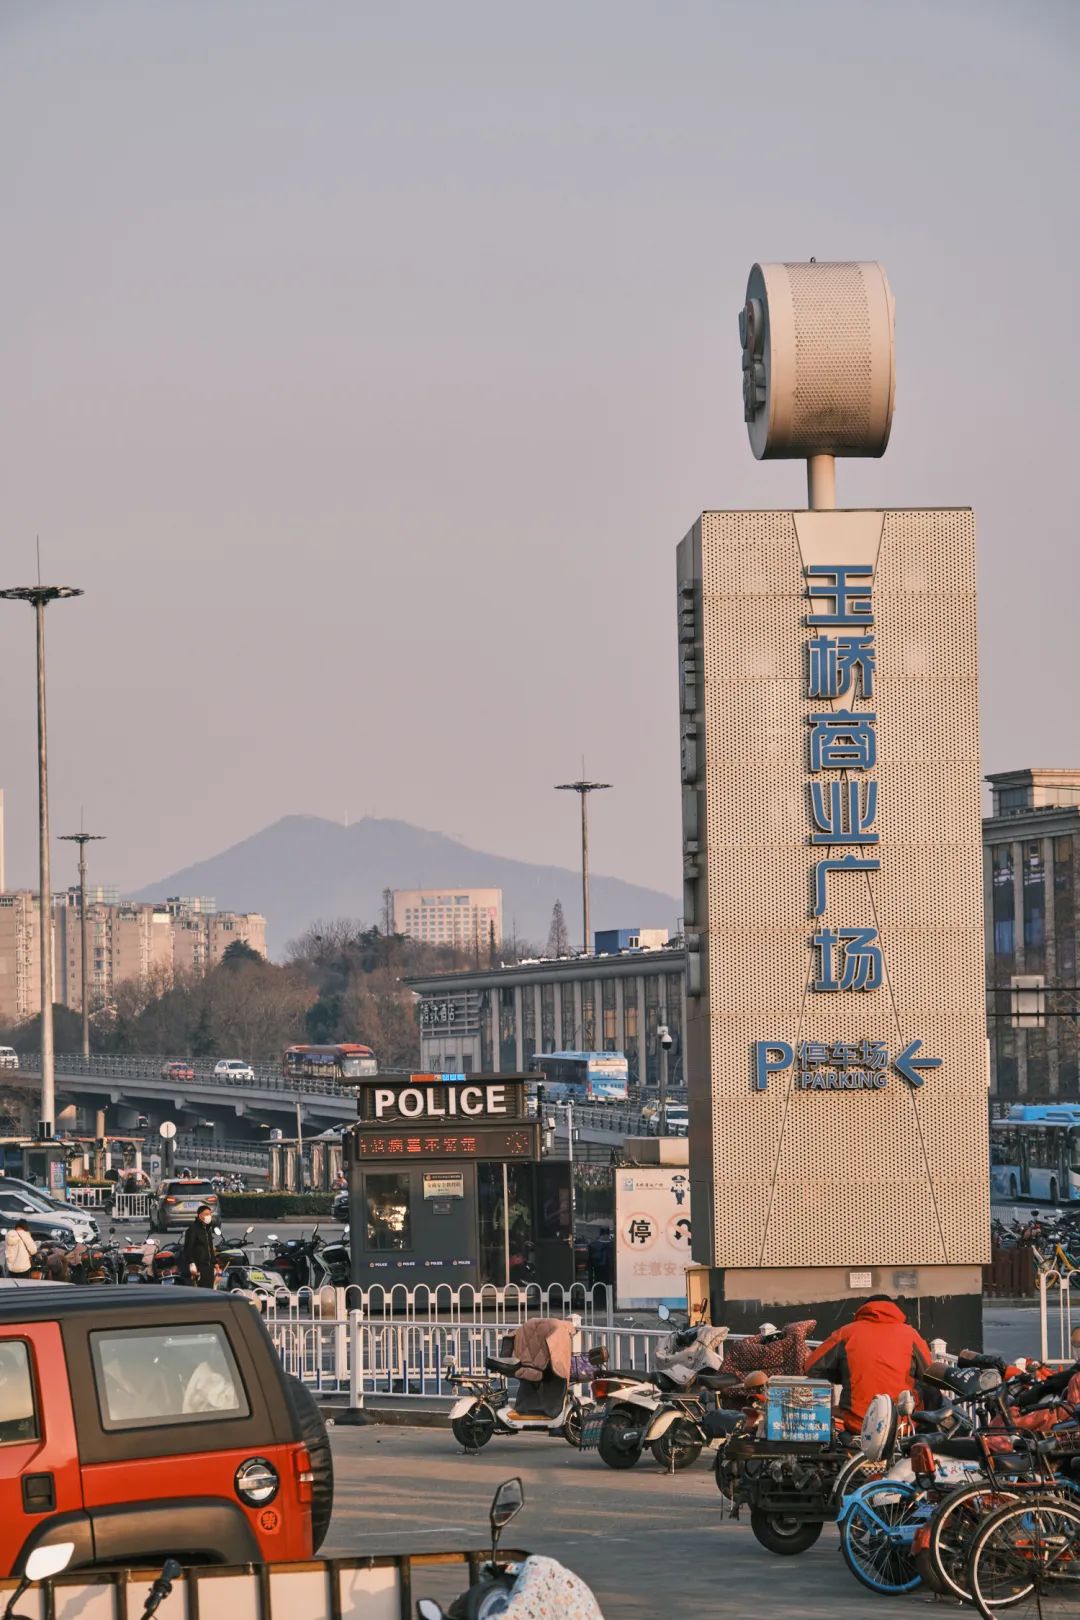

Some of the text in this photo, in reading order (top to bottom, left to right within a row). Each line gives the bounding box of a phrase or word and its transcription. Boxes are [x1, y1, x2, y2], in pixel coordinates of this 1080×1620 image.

[806, 564, 883, 992] 玉桥商业广场
[756, 1040, 795, 1090] P
[799, 1039, 889, 1071] 停车场
[801, 1072, 888, 1089] PARKING
[375, 1085, 507, 1117] POLICE
[628, 1220, 652, 1243] 停
